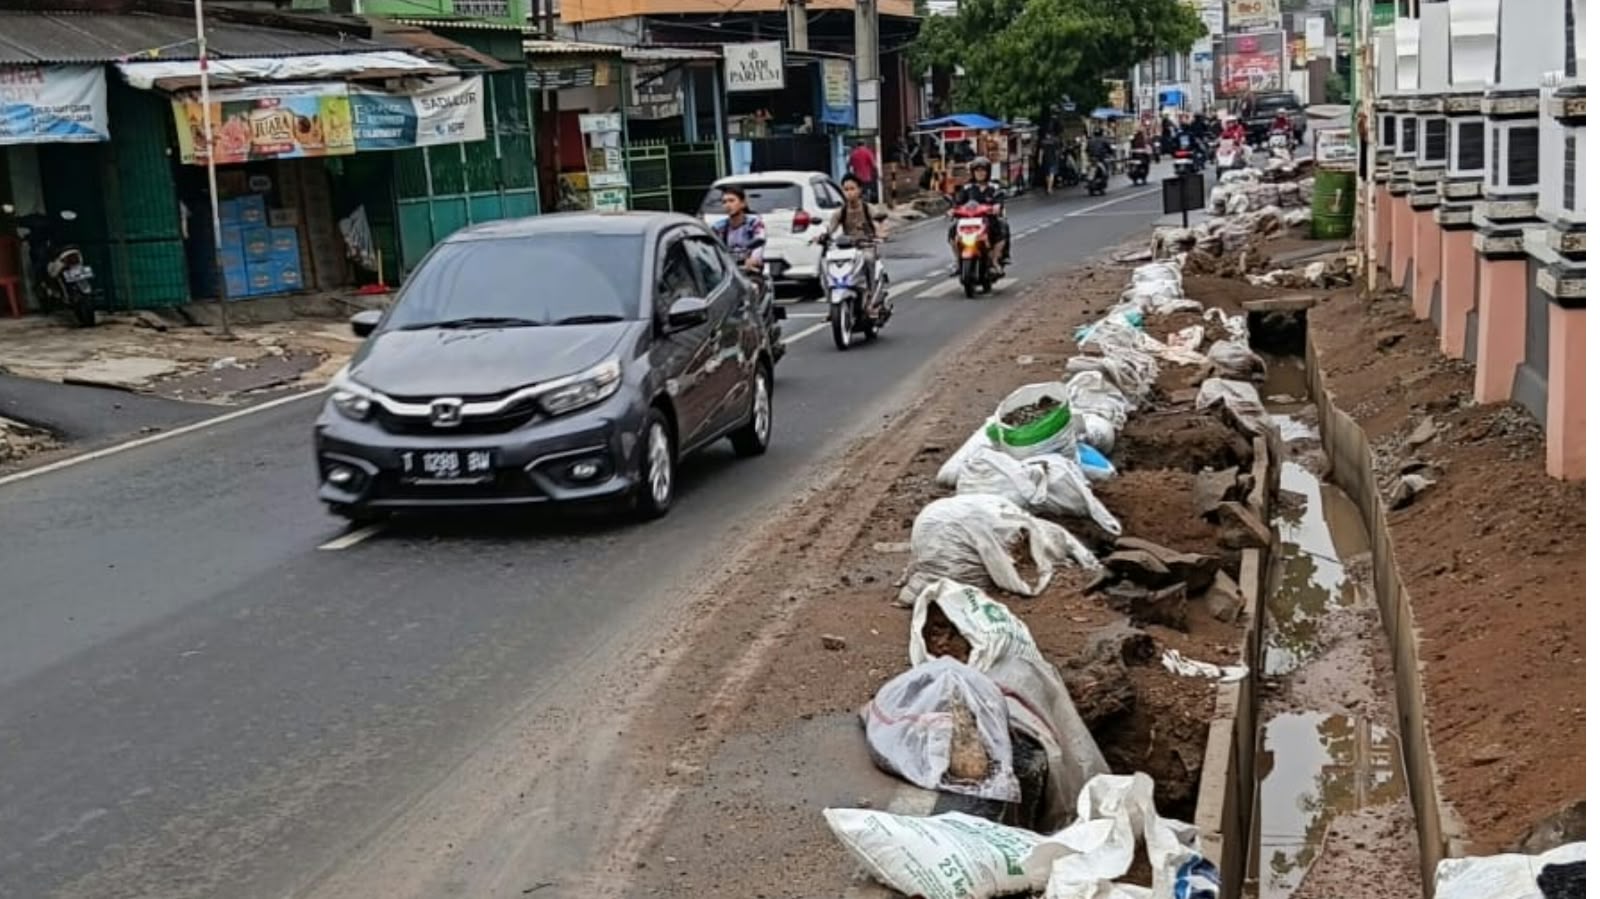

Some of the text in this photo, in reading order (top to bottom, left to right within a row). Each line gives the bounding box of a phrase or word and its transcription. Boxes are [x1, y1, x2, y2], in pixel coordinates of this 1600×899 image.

[729, 69, 780, 82] PARFUM
[938, 857, 954, 878] 25
[951, 877, 968, 899] kg
